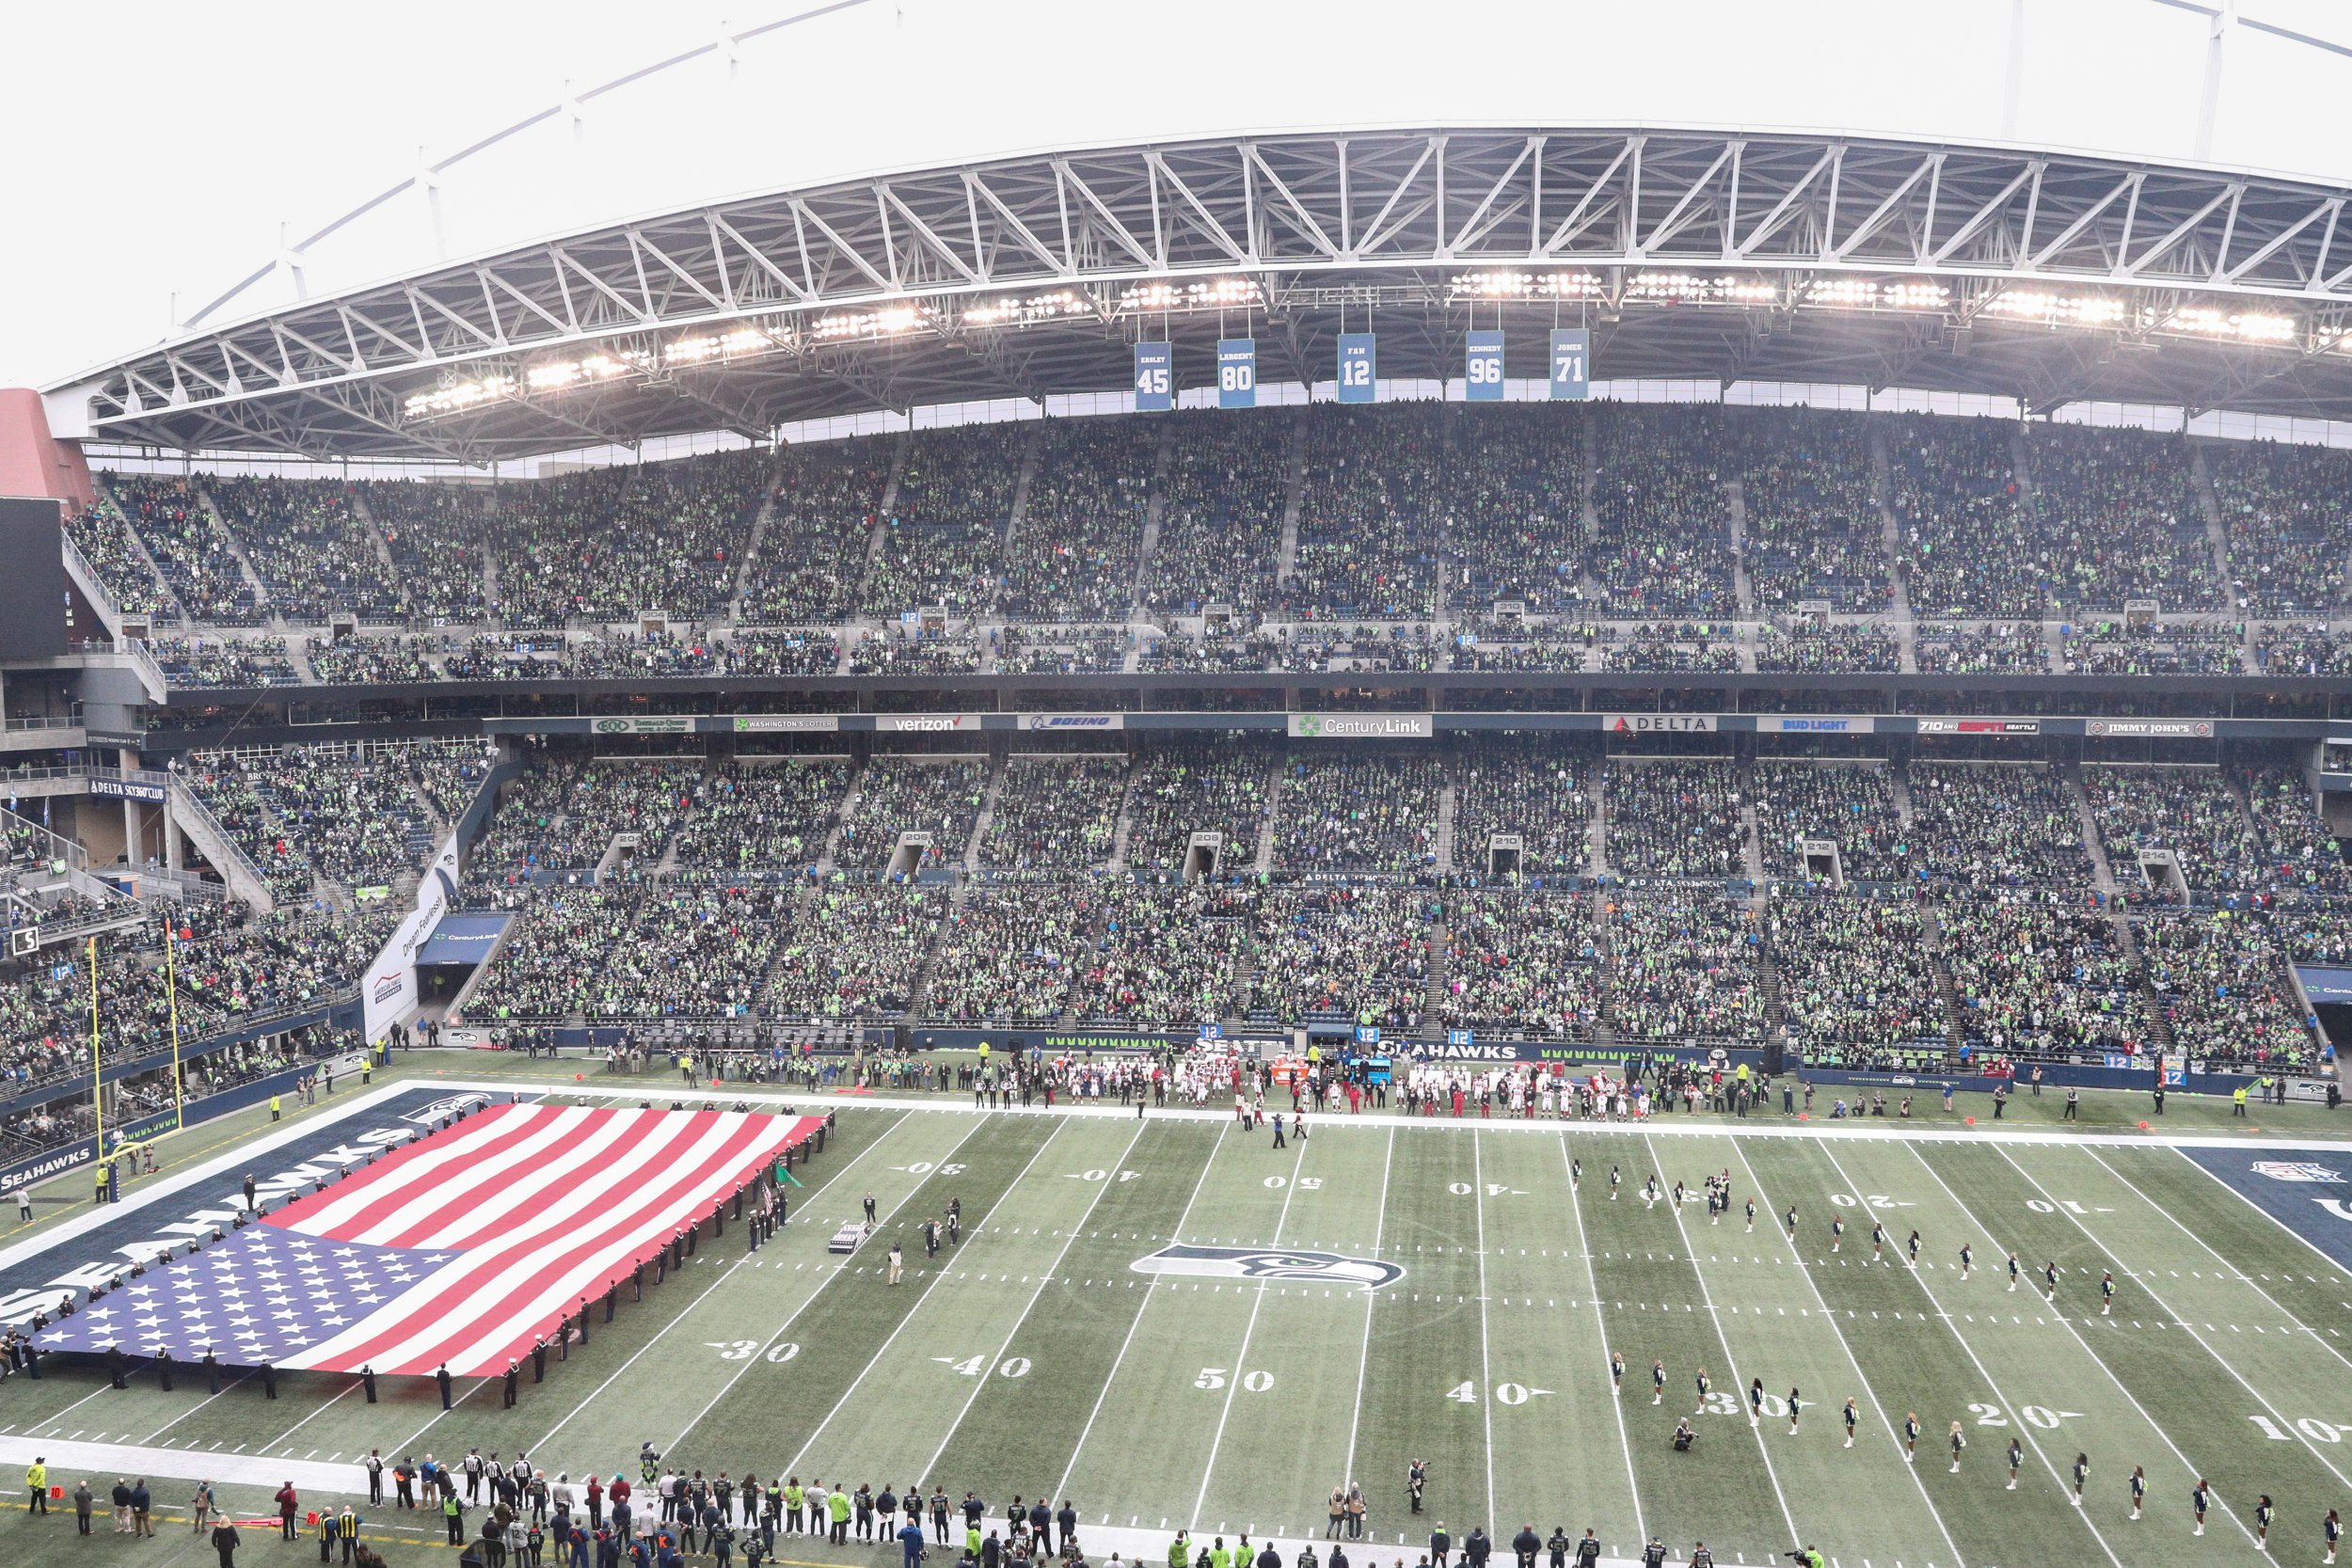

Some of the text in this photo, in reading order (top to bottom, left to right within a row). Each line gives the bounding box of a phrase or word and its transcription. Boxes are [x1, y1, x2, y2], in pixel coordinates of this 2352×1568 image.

[1218, 352, 1254, 361] LARGENT
[1347, 347, 1366, 356] FAN
[1343, 360, 1370, 386] 12
[1470, 358, 1501, 384] 96
[1556, 356, 1583, 382] 71
[1136, 369, 1168, 394] 45
[1221, 366, 1252, 391] 80
[433, 617, 446, 627] 12
[905, 612, 916, 623] 12
[1461, 635, 1473, 645] 12
[519, 644, 530, 654] 12
[600, 720, 628, 732] EQC
[895, 717, 954, 732] verizon
[1049, 717, 1110, 725] BOEING
[1325, 719, 1422, 736] CenturyLink
[1637, 717, 1708, 730] DELTA
[1782, 720, 1849, 731] BUD LIGHT
[1919, 721, 1943, 732] 710
[2107, 723, 2148, 734] JIMMY
[2150, 723, 2190, 735] JOHN'S
[98, 782, 123, 796] DELTA
[148, 787, 164, 800] CLUB
[2141, 851, 2167, 860] 214
[420, 895, 443, 933] Fearlessly
[403, 928, 421, 958] Dream
[448, 932, 499, 942] CenturyLink
[56, 966, 69, 981] 12
[1205, 1026, 1217, 1038] 12
[1360, 1028, 1375, 1043] 12
[1454, 1031, 1469, 1045] 12
[1377, 1040, 1517, 1059] SAHAWKS
[2108, 1056, 2127, 1069] 12
[2163, 1071, 2182, 1085] 12
[0, 1148, 90, 1191] SEAHAWKS
[721, 1339, 800, 1363] 30
[952, 1354, 1032, 1378] 40
[1194, 1368, 1275, 1391] 50
[1445, 1381, 1529, 1405] 40
[1968, 1402, 2060, 1428] 20
[2248, 1416, 2342, 1443] 10
[51, 1487, 60, 1498] 10
[307, 1512, 317, 1524] 20
